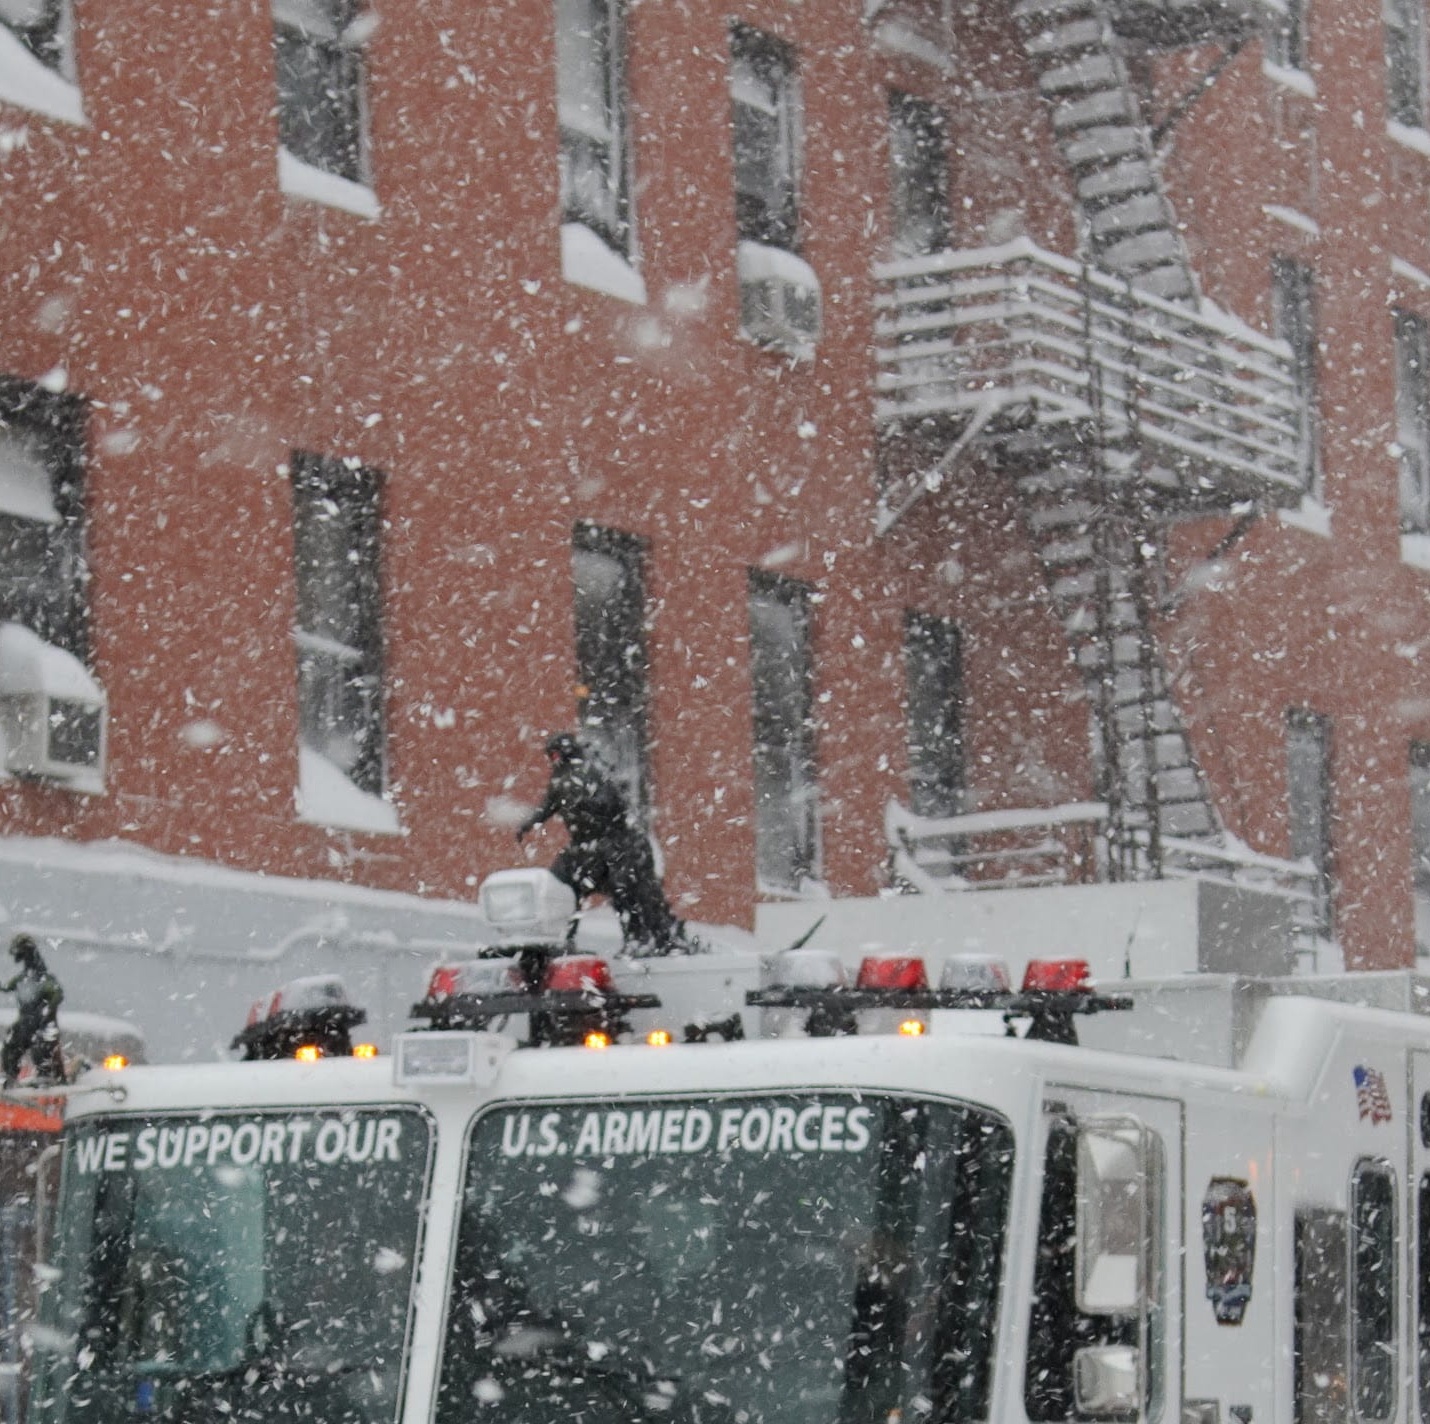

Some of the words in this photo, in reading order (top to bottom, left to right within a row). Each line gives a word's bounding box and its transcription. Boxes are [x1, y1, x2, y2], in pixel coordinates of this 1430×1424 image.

[77, 1131, 130, 1175] WE
[133, 1117, 312, 1170] SUPPORT
[315, 1118, 401, 1163] OUR
[502, 1112, 568, 1156] U.S.
[574, 1108, 713, 1154] ARMED
[717, 1105, 871, 1152] FORCES
